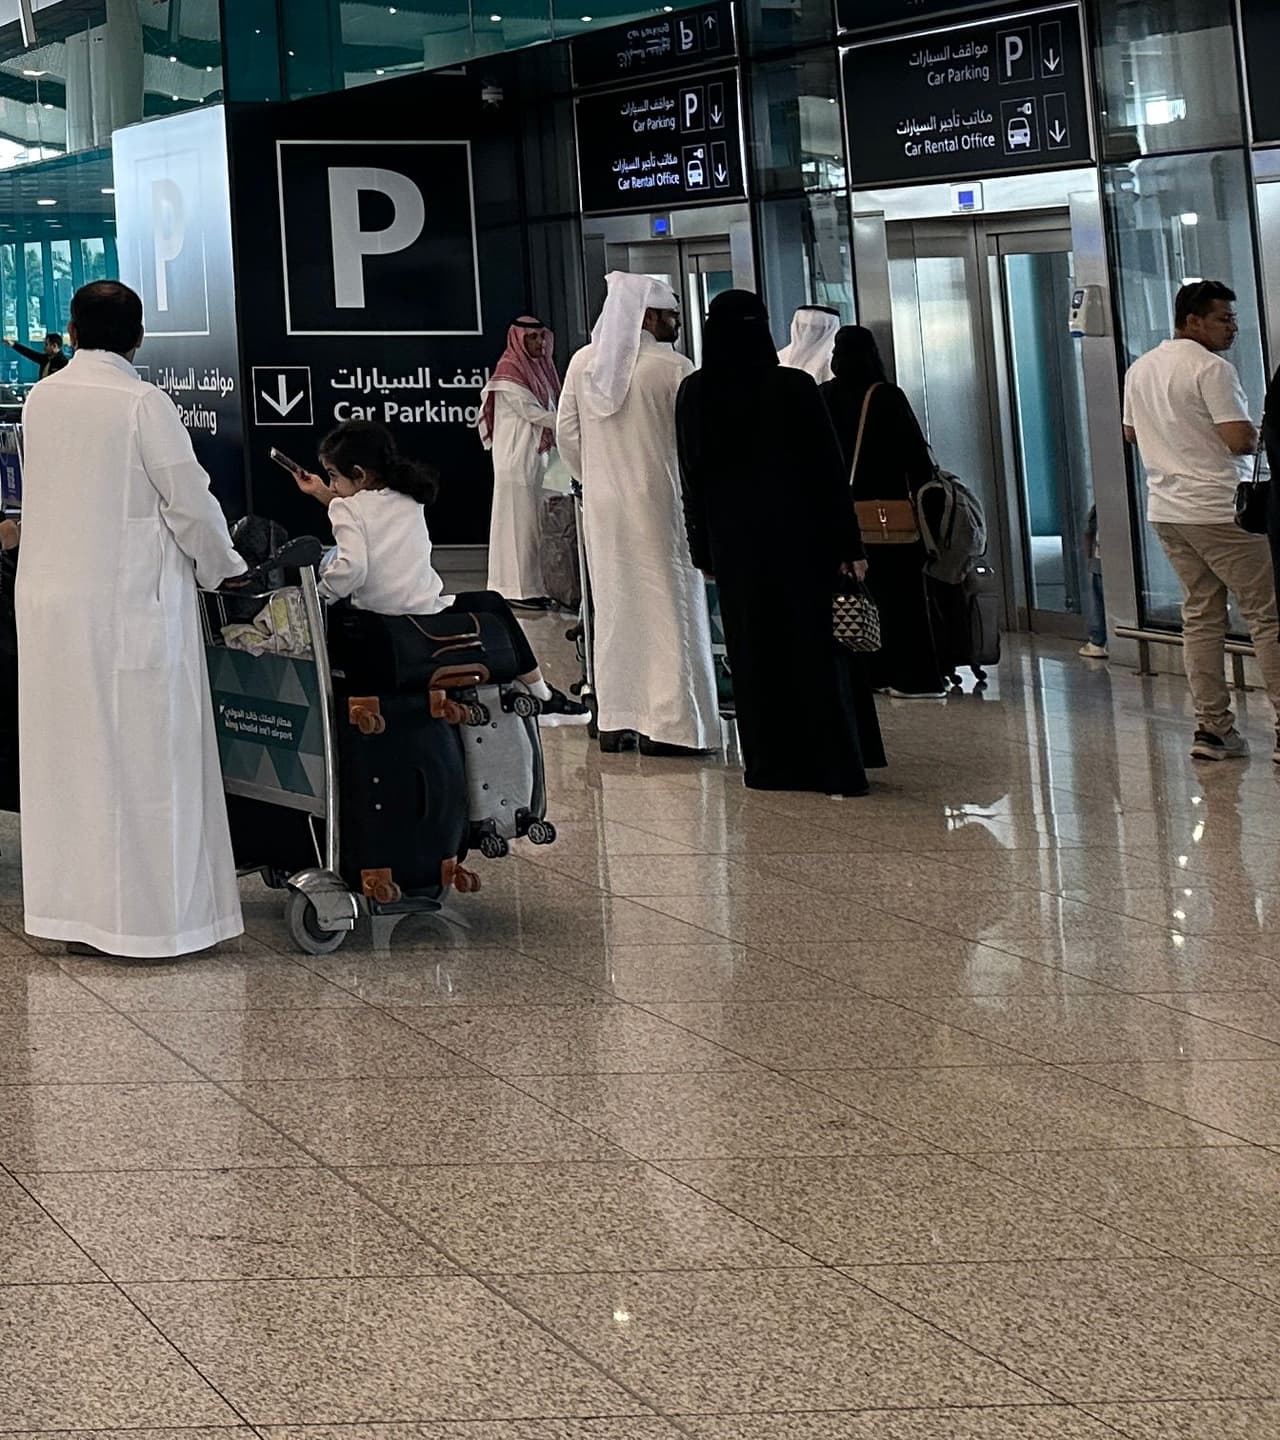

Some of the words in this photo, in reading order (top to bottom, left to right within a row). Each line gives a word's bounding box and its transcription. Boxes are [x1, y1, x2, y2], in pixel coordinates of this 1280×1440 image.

[909, 45, 950, 68] السيارات
[952, 41, 989, 59] مواقف
[1005, 35, 1023, 77] P
[927, 71, 945, 86] Car
[948, 65, 990, 82] Parking
[620, 100, 649, 116] السيارات
[650, 96, 675, 111] مواقف
[685, 93, 698, 127] P
[633, 120, 645, 133] Car
[647, 116, 675, 131] Parking
[896, 117, 937, 137] السيارات
[939, 108, 961, 132] تأجير
[963, 109, 993, 127] مكاتب
[904, 141, 922, 157] Car
[924, 137, 959, 154] Rental
[961, 132, 996, 150] Office
[612, 158, 640, 174] السيارات
[658, 153, 678, 166] مكاتب
[618, 177, 630, 190] Car
[632, 174, 655, 189] Rental
[656, 172, 680, 186] Office
[327, 166, 425, 309] P
[197, 367, 234, 398] مواقف
[330, 367, 431, 395] السيارات
[333, 401, 376, 424] Car
[385, 400, 480, 428] Parking
